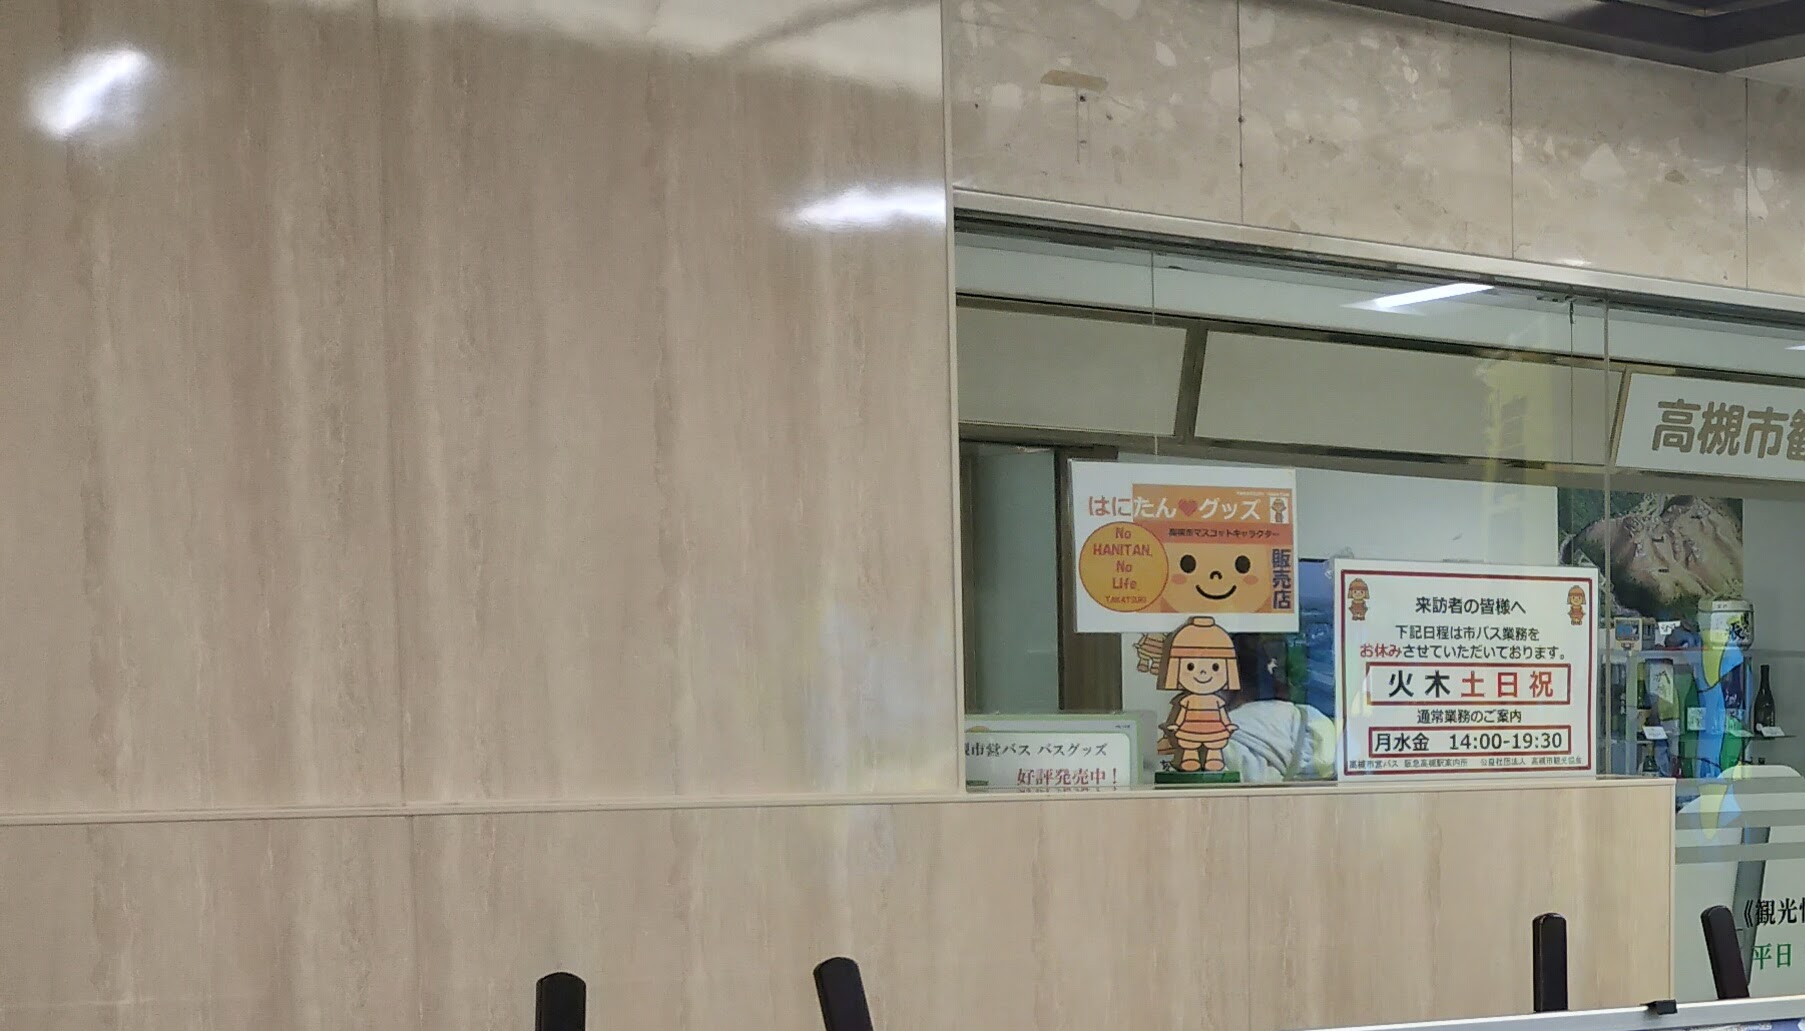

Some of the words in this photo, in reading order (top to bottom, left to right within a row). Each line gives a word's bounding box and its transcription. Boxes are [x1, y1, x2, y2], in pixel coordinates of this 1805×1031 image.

[1089, 496, 1176, 520] はにたん
[1200, 498, 1261, 521] グッズ
[1115, 527, 1132, 539] No
[1116, 561, 1133, 573] No
[1271, 548, 1292, 611] 販売店
[1416, 597, 1526, 615] 来訪者の皆様へ
[1395, 624, 1540, 641] 下記日程は市バス業務を
[1360, 643, 1566, 660] お休みさせていただいております。
[1417, 710, 1522, 724] 通常業務のご案内
[1037, 743, 1109, 757] バスグッズ
[1374, 733, 1430, 752] 月水金
[1449, 733, 1562, 750] 14:00-19:30
[1349, 760, 1399, 770] 高槻市営バス
[1752, 943, 1793, 970] 平日
